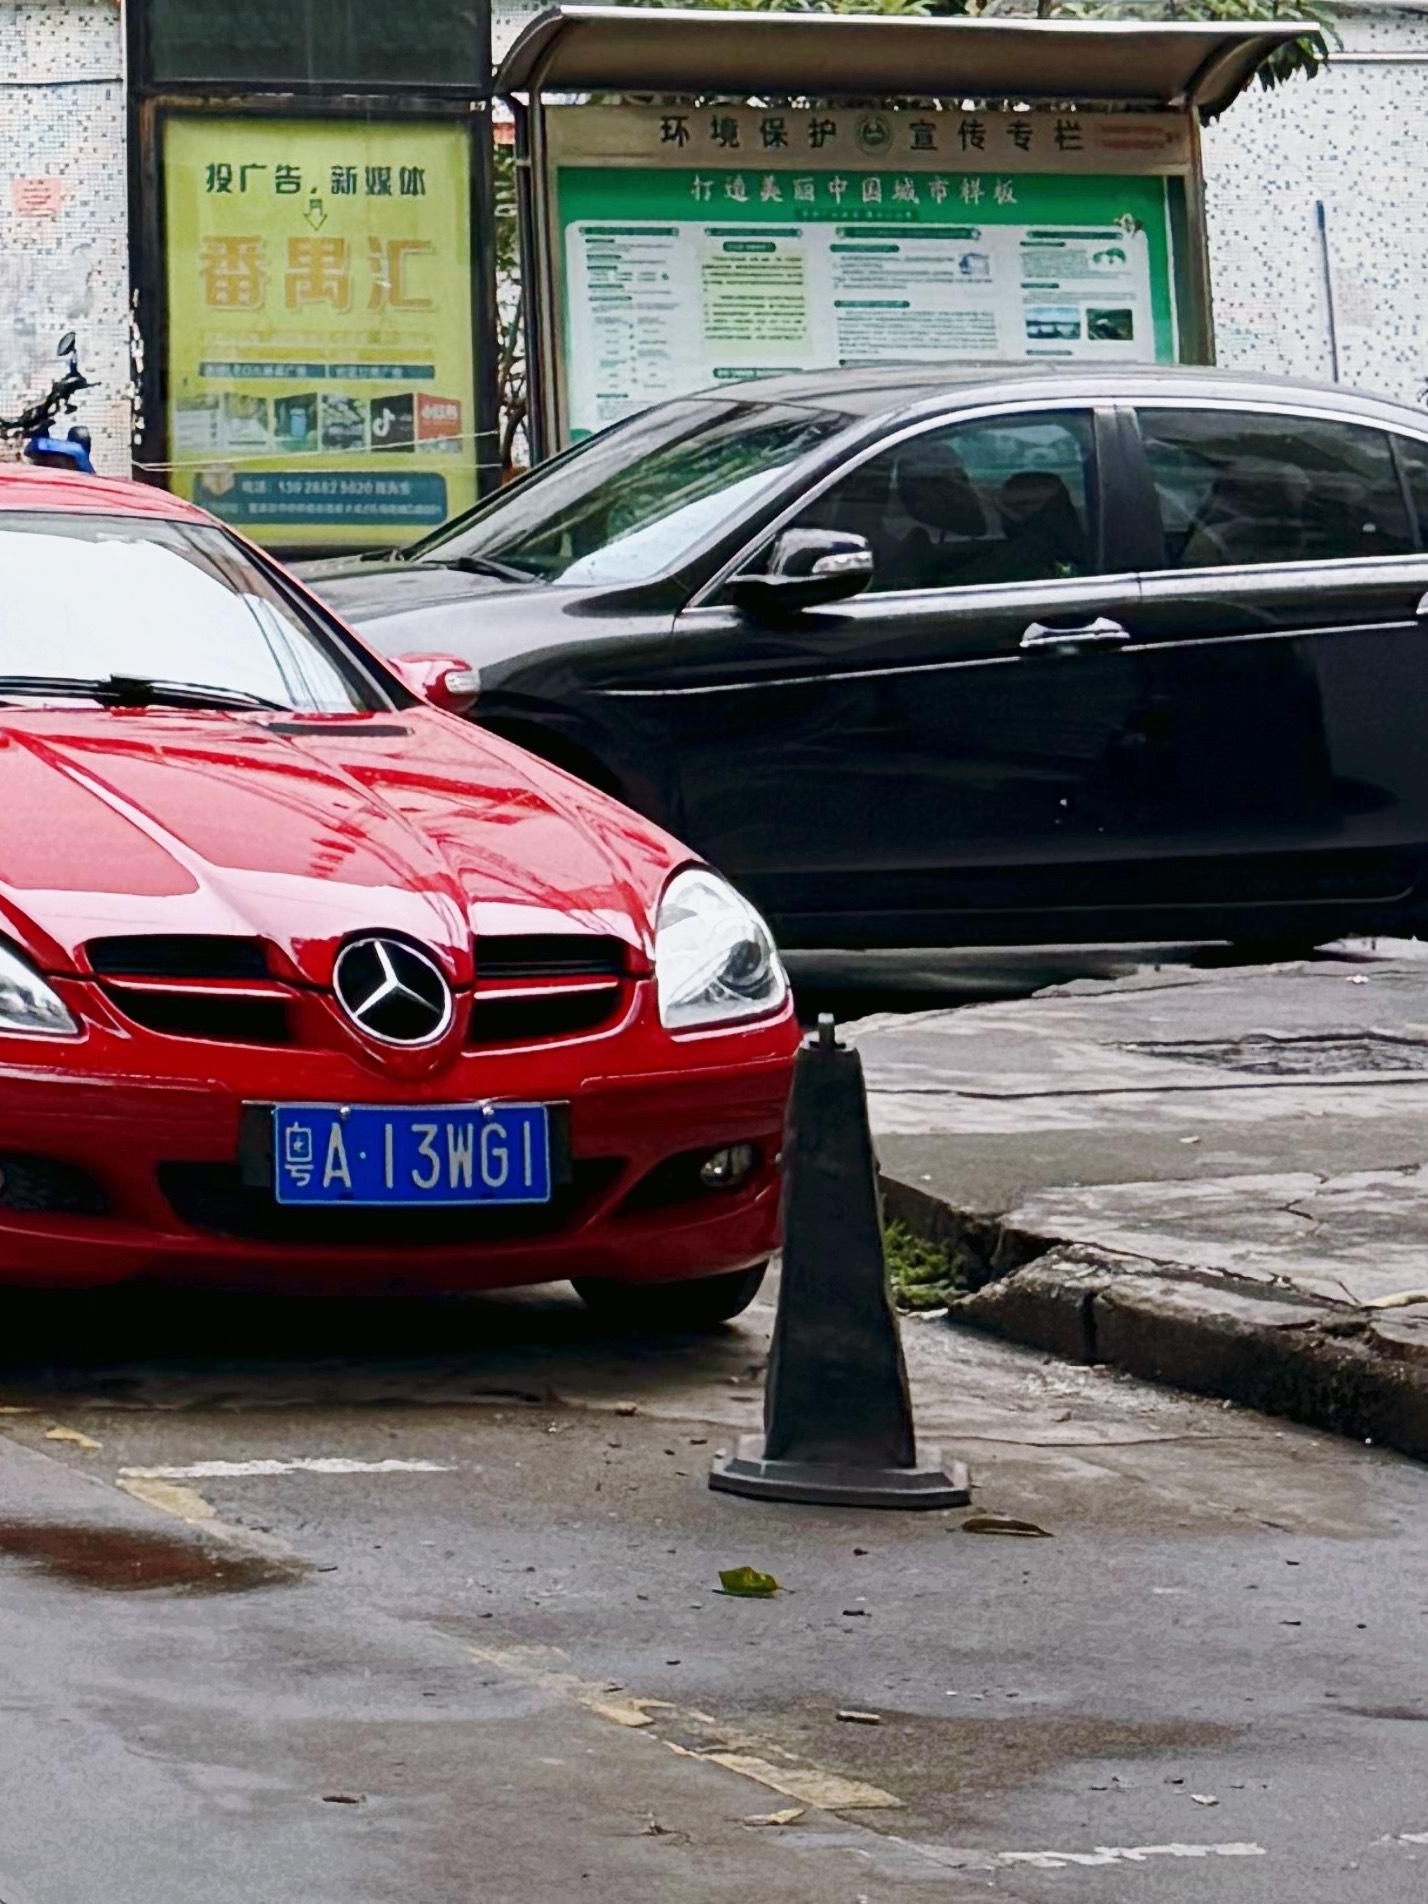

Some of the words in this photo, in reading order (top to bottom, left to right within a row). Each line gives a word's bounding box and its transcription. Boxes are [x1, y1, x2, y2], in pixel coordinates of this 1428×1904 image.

[660, 114, 838, 150] 环境保护
[908, 117, 1084, 153] 宣传专栏
[199, 235, 438, 313] 番禺汇
[284, 1120, 533, 1189] 粤A·13WG1
